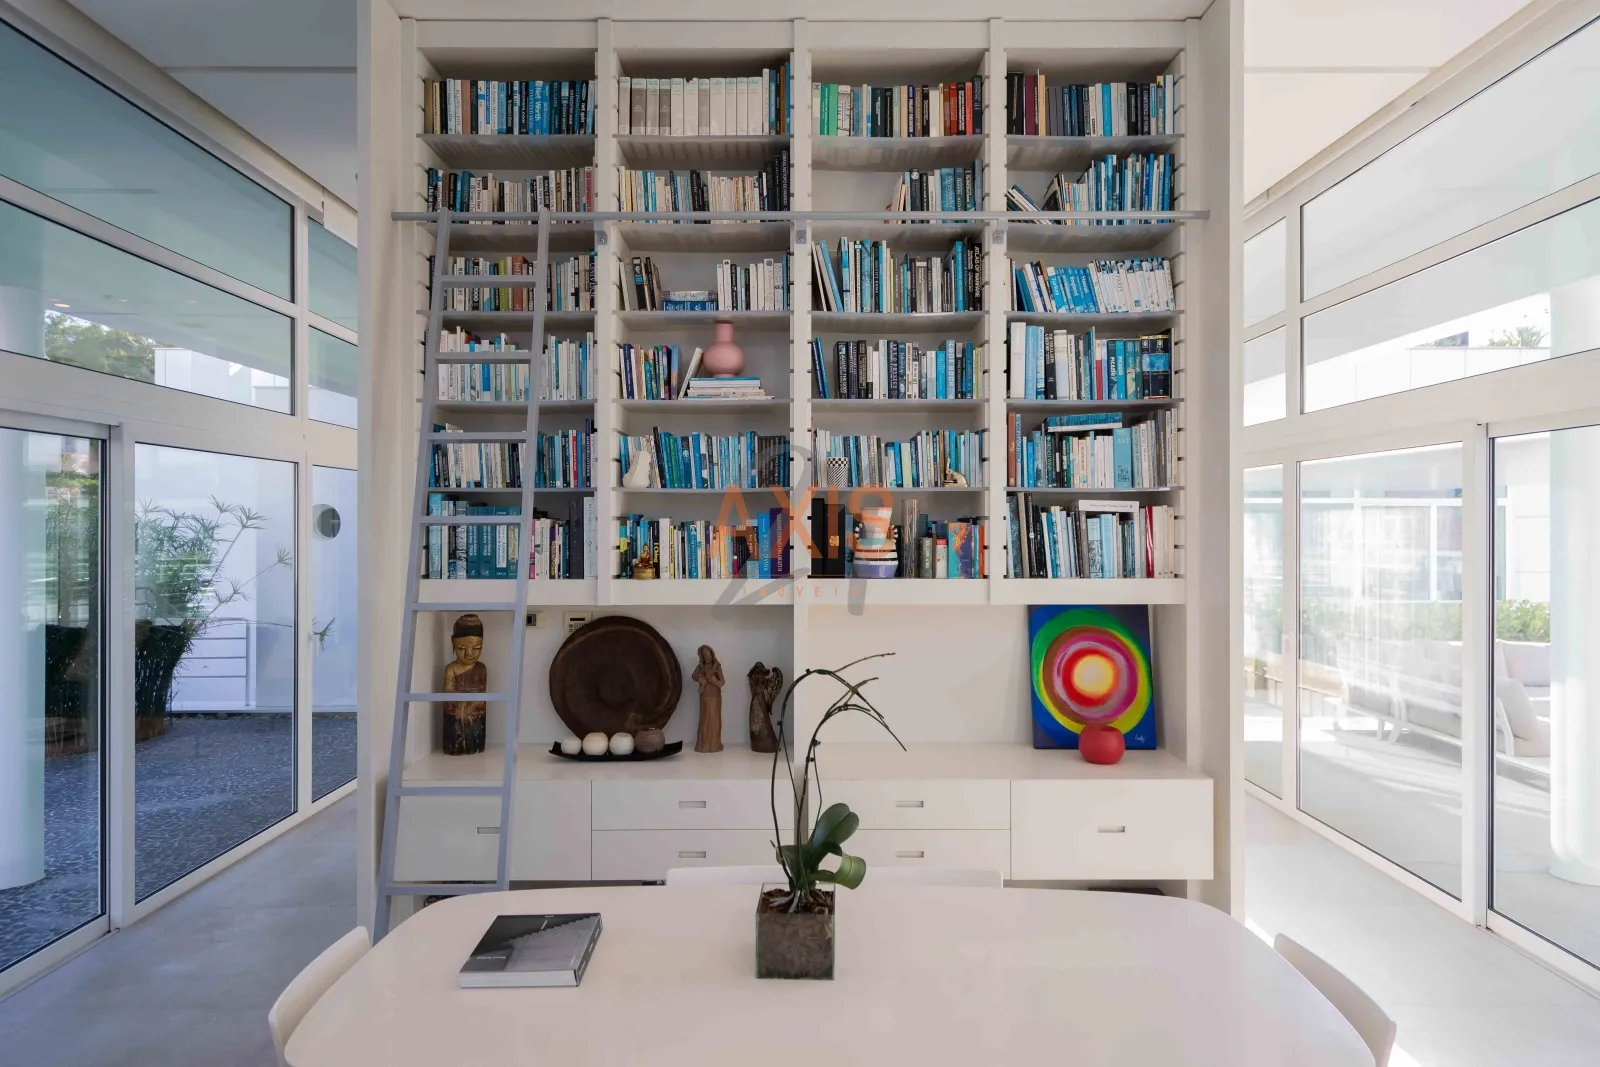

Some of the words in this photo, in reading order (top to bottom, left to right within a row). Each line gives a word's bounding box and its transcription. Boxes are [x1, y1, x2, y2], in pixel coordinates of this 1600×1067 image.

[1051, 278, 1060, 296] Turkey
[1070, 277, 1079, 296] England
[1081, 276, 1090, 294] Hawaii
